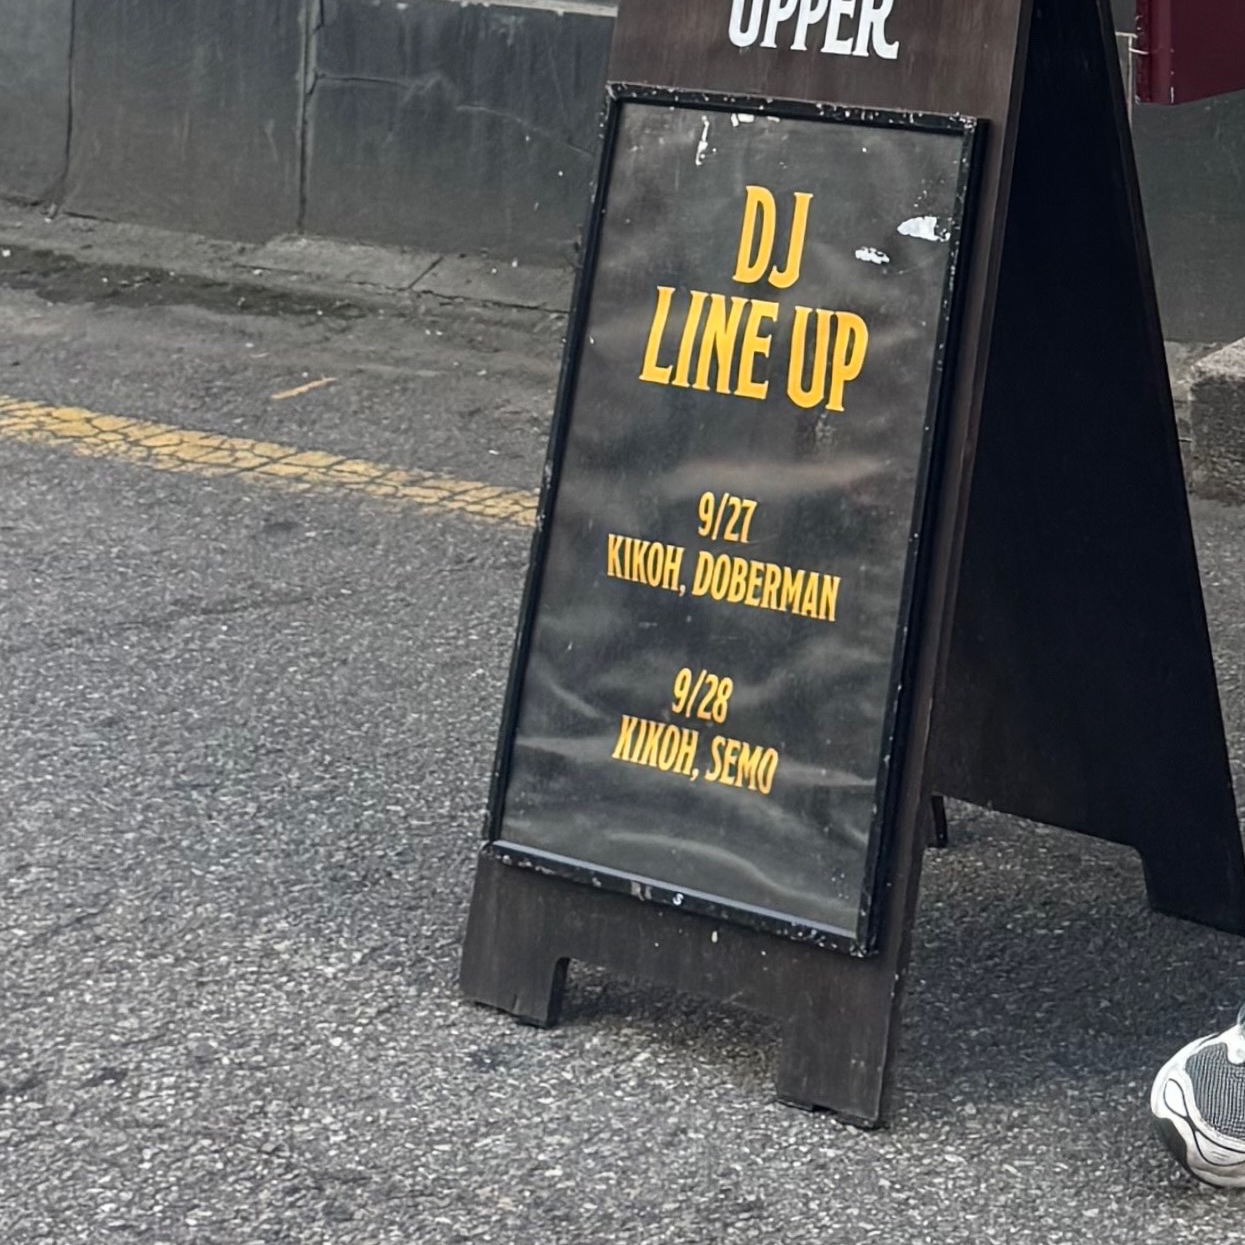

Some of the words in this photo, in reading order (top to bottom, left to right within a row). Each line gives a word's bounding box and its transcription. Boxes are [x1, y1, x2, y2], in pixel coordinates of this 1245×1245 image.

[732, 185, 814, 288] DJ
[639, 285, 779, 400] LINE
[787, 305, 869, 411] UP
[697, 491, 757, 543] 9/27
[606, 533, 686, 597] KIKOH,
[692, 551, 841, 622] DOBERMAN
[671, 667, 733, 724] 9/28
[611, 714, 699, 781] KIKOH,
[704, 735, 779, 795] SEMO
